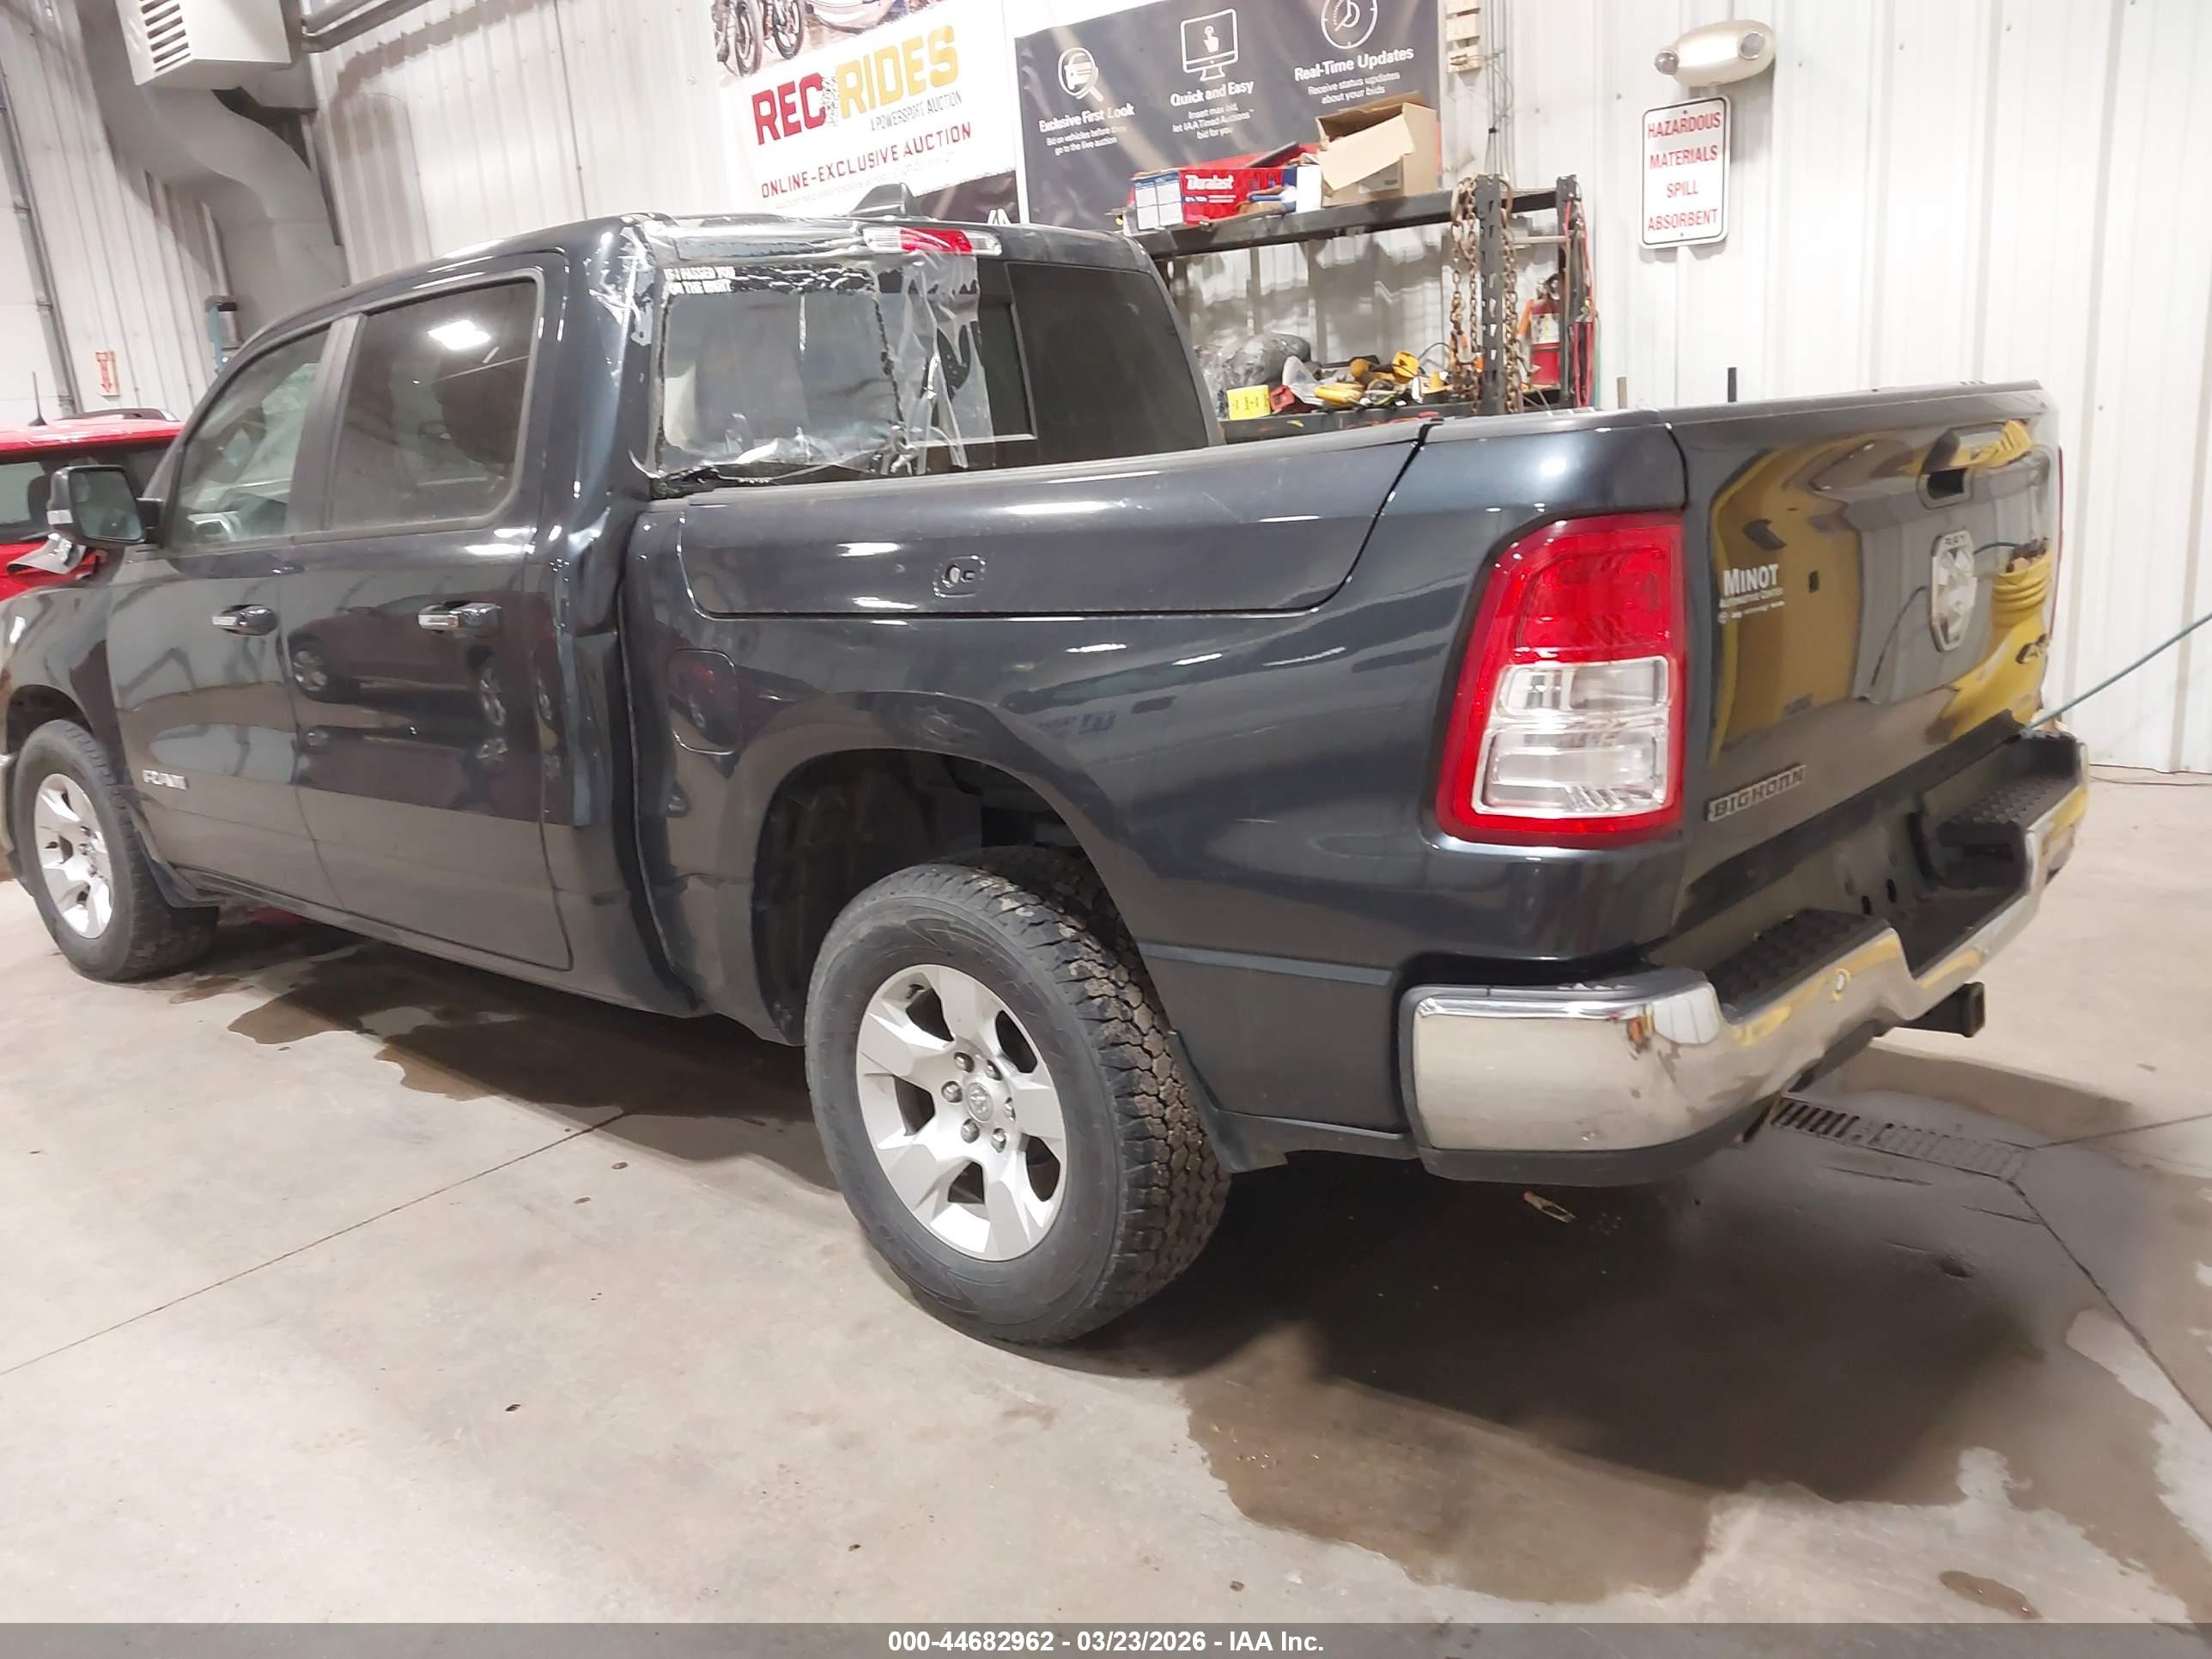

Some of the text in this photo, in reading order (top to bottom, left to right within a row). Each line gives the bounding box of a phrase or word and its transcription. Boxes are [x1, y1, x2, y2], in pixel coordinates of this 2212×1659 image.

[1294, 48, 1415, 82] Real-Time Updates
[751, 25, 959, 146] REC RIDES
[1170, 81, 1255, 107] Quick and Easy
[1308, 71, 1401, 96] Receive status updates
[1321, 85, 1386, 105] about your bids
[927, 90, 963, 114] AUCTION
[1038, 102, 1135, 133] Exclusive First Look
[1647, 112, 1722, 138] HAZARDOUS
[761, 144, 899, 198] ONLINE-EXCLUSIVE
[902, 120, 971, 158] AUCTION
[1649, 144, 1718, 170] MATERIALS
[1184, 174, 1235, 191] Duralast
[1666, 179, 1699, 198] SPILL
[1647, 208, 1718, 232] ABSORBENT
[1723, 563, 1779, 597] MINOT
[1708, 764, 1807, 822] BIGHORN
